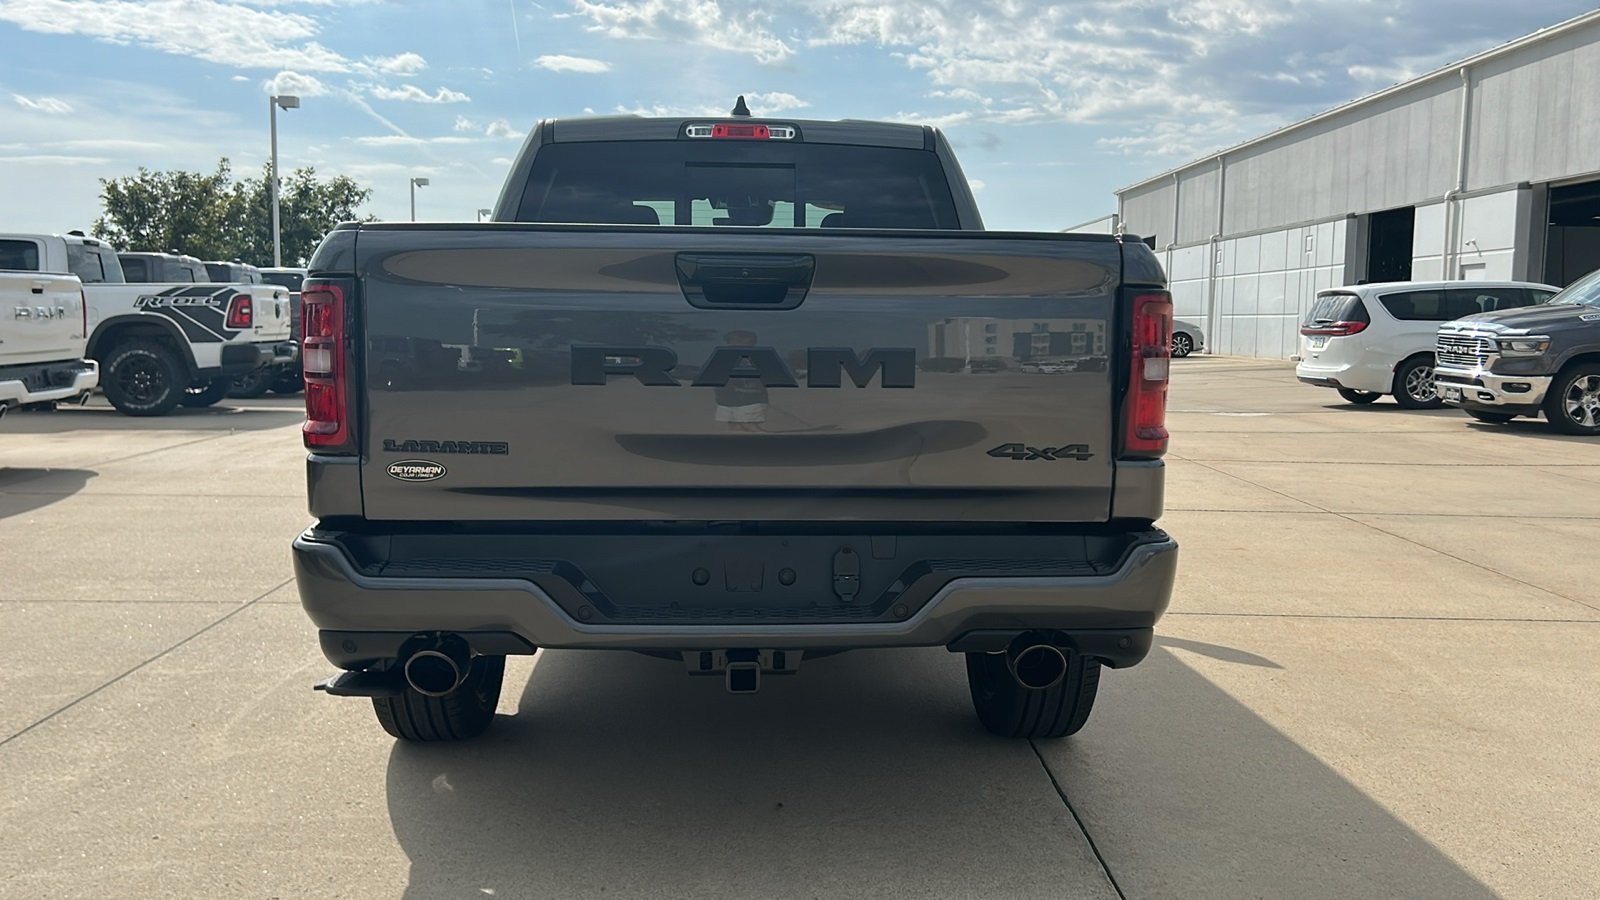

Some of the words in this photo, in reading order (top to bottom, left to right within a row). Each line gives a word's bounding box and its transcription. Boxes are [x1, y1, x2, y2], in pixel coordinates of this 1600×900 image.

[133, 295, 221, 308] REBEL
[571, 344, 915, 388] RAM
[383, 439, 509, 455] LARAMIE
[986, 443, 1095, 461] 4x4
[390, 466, 442, 474] DEYARMAN
